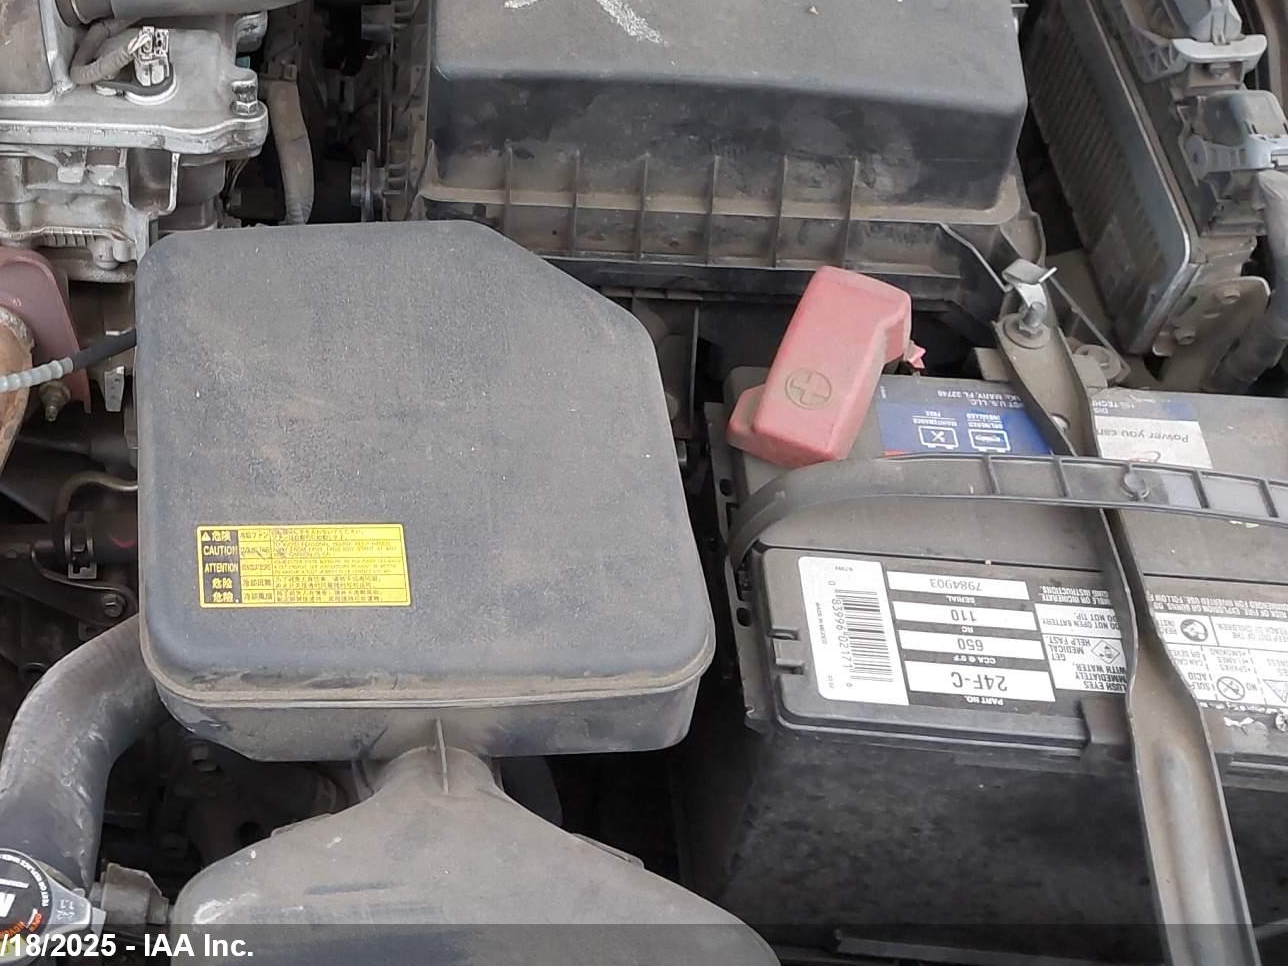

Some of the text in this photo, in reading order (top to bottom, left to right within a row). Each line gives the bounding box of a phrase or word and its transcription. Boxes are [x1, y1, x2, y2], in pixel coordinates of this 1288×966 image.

[1096, 429, 1189, 443] Power you can
[203, 545, 238, 556] CAUTION
[204, 562, 239, 573] ATTENTION
[929, 578, 982, 592] 7984903
[946, 595, 976, 604] SERIAL
[950, 609, 976, 622] 110
[1089, 613, 1105, 622] NOT
[961, 625, 974, 633] RC
[1073, 620, 1092, 628] OPEN
[1093, 621, 1109, 629] NOT
[957, 638, 984, 652] 650
[1071, 638, 1091, 647] HELP
[1048, 644, 1085, 655] MEDICAL
[978, 655, 996, 665] CCA
[1051, 653, 1066, 662] GET
[950, 671, 1008, 692] 24F-C
[1187, 672, 1207, 681] ACID
[1083, 680, 1105, 690] EYES
[981, 696, 1004, 706] PART
